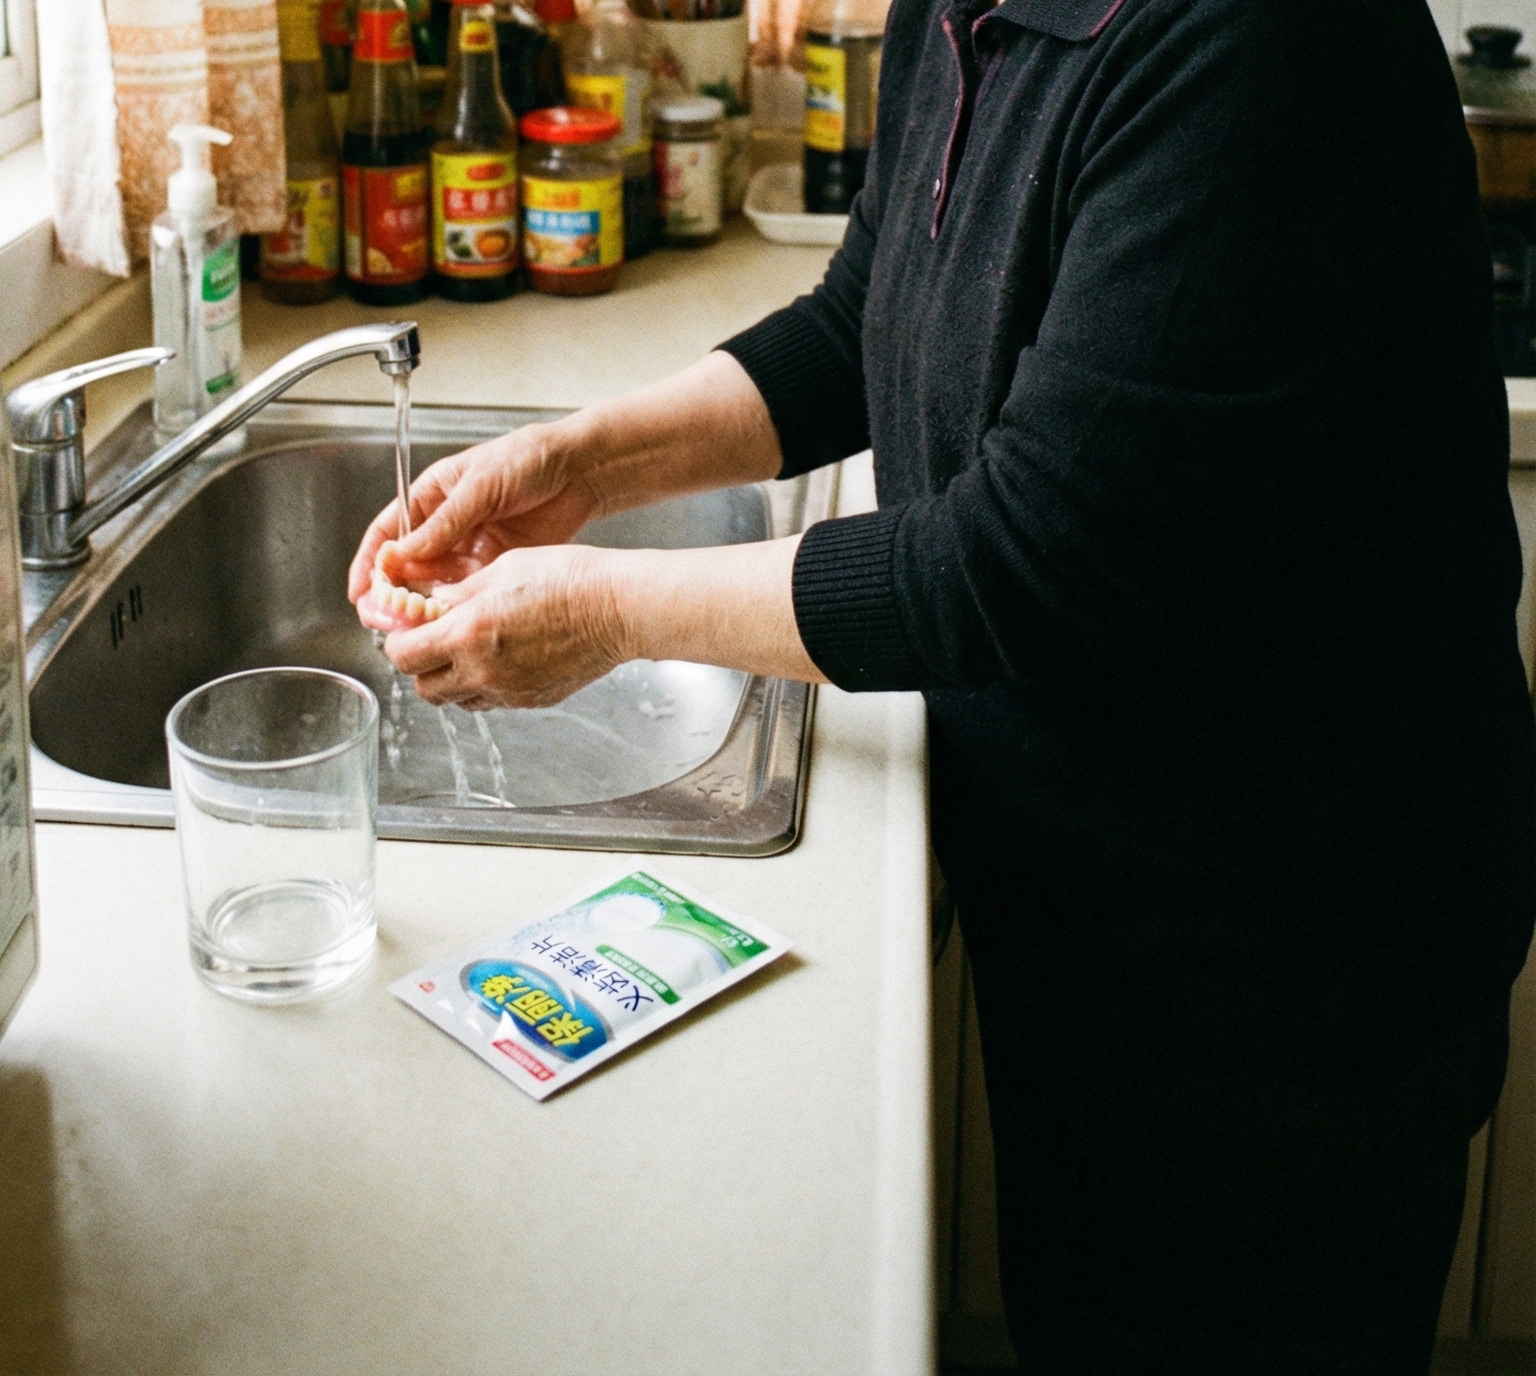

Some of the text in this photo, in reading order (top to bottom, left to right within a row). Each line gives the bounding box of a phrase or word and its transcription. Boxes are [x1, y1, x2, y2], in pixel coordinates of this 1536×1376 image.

[480, 972, 594, 1048] 保丽净
[530, 934, 654, 1011] 义齿清洁片
